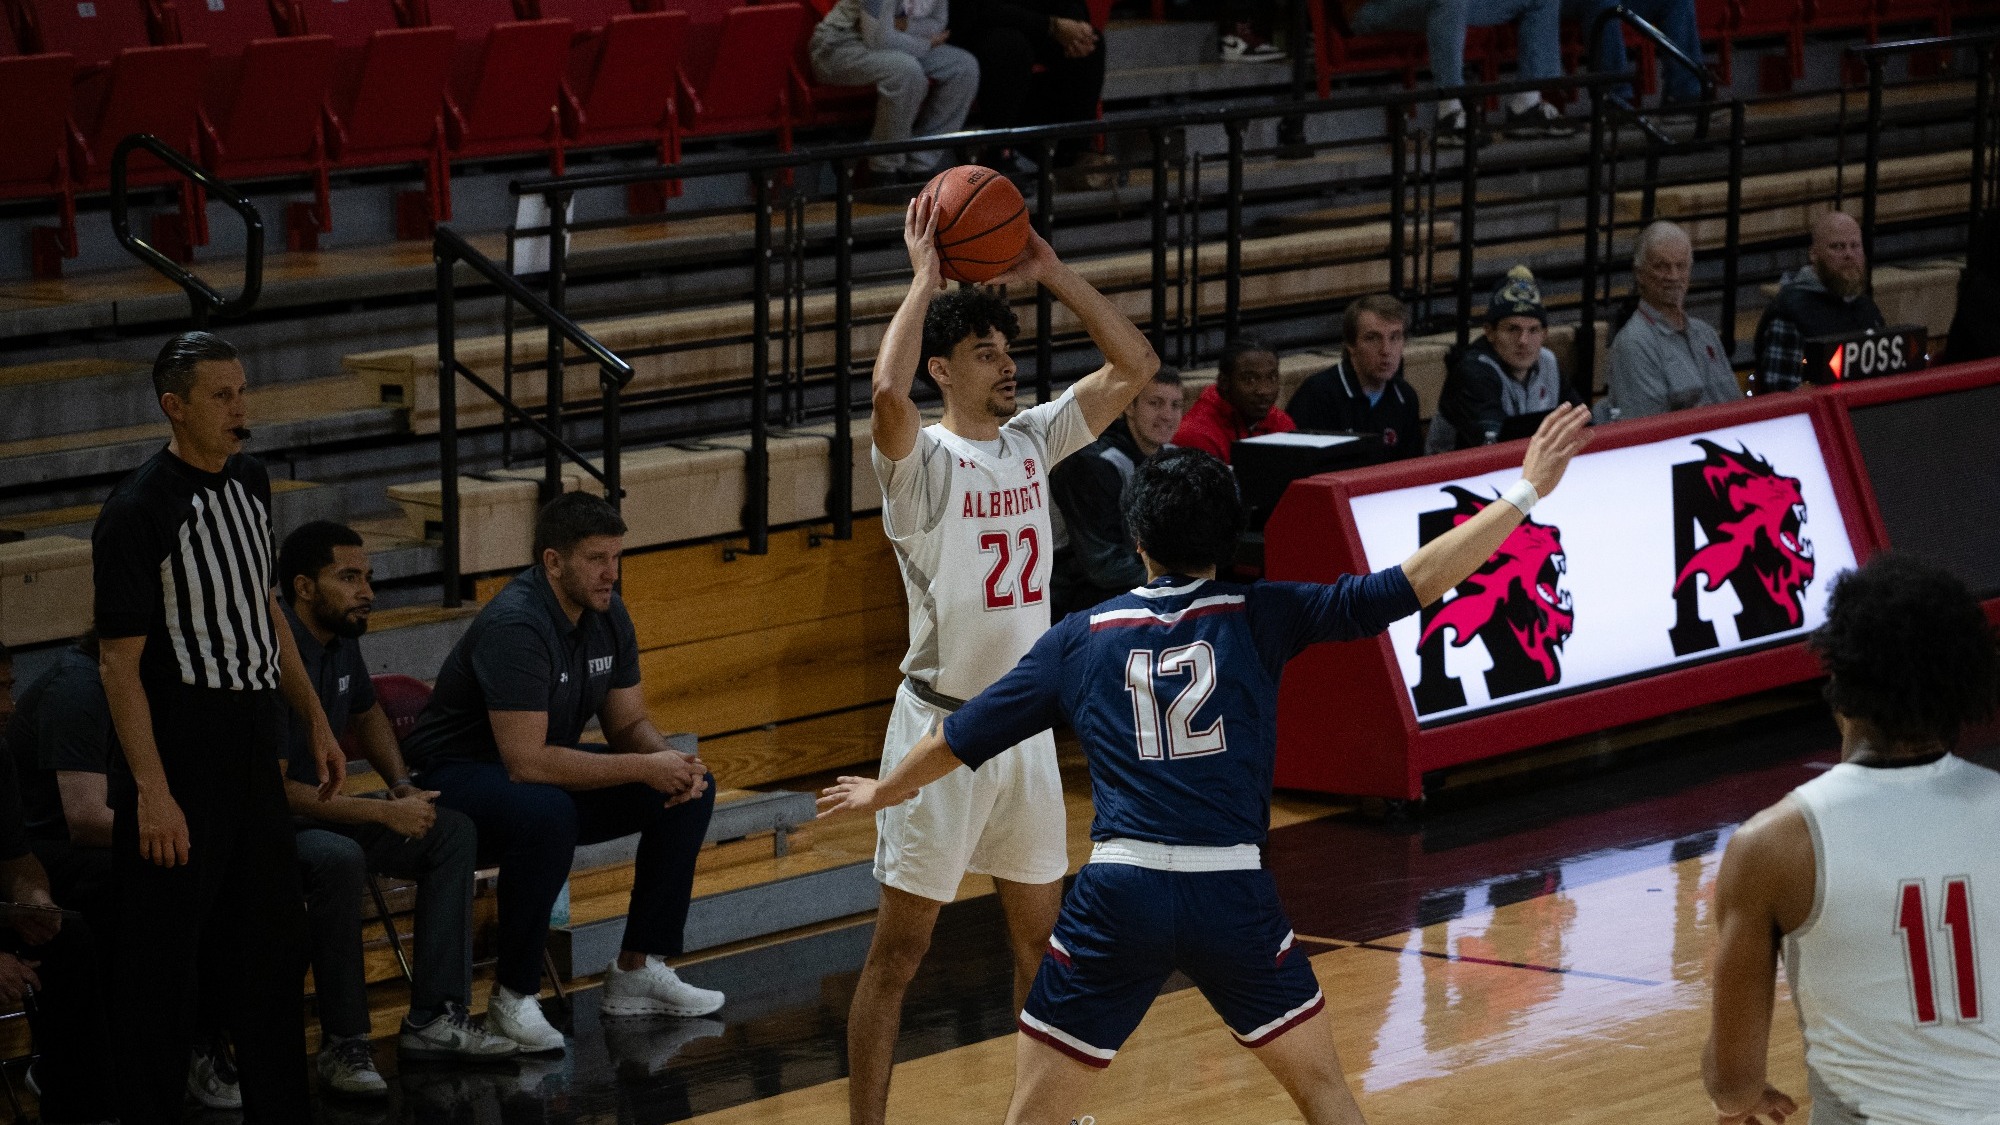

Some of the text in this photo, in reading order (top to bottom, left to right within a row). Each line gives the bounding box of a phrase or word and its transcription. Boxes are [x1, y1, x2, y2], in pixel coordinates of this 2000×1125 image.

[1843, 335, 1908, 378] POSS.
[978, 525, 1043, 611] 22
[588, 655, 613, 674] FDU
[1124, 640, 1227, 760] 12
[1893, 875, 1983, 1027] 11
